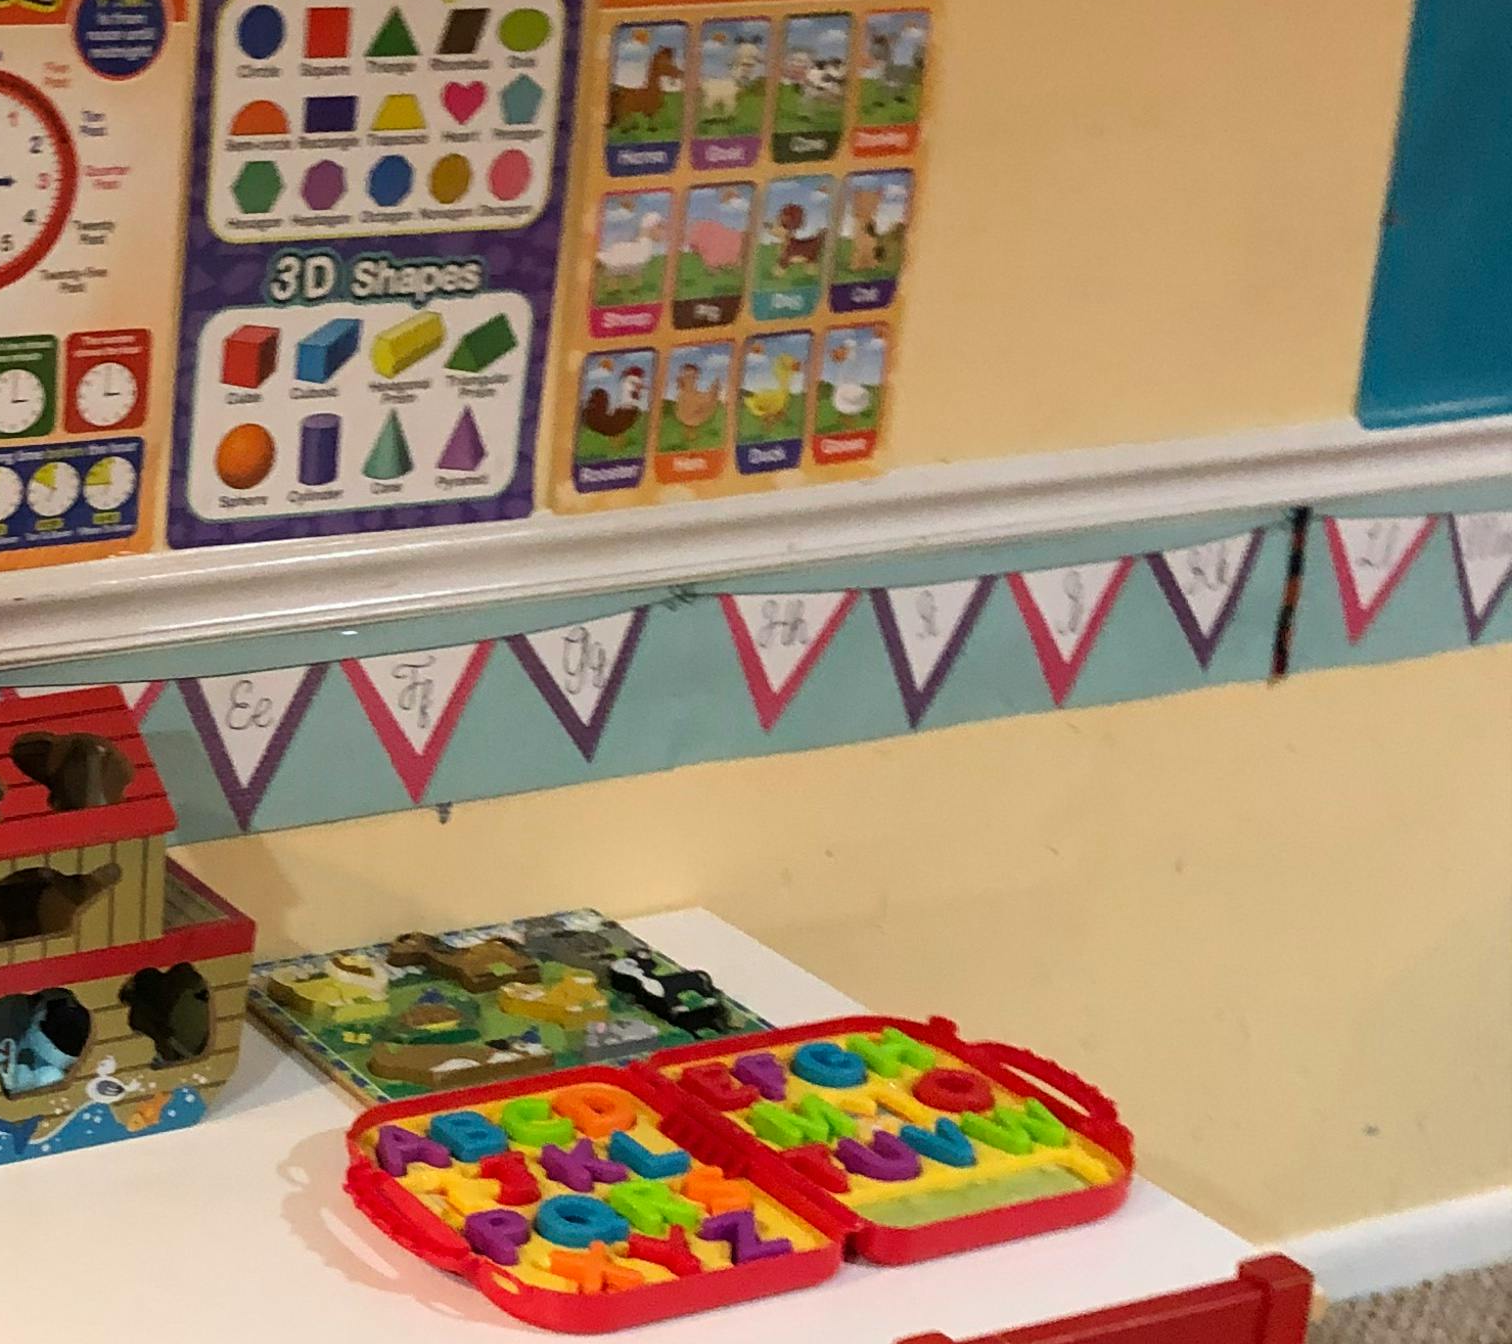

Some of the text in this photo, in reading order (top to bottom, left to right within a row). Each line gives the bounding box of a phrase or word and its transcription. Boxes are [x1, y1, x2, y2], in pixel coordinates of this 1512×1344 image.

[269, 253, 483, 306] 3D Shapes
[224, 679, 275, 731] Ee
[430, 1111, 508, 1162] B
